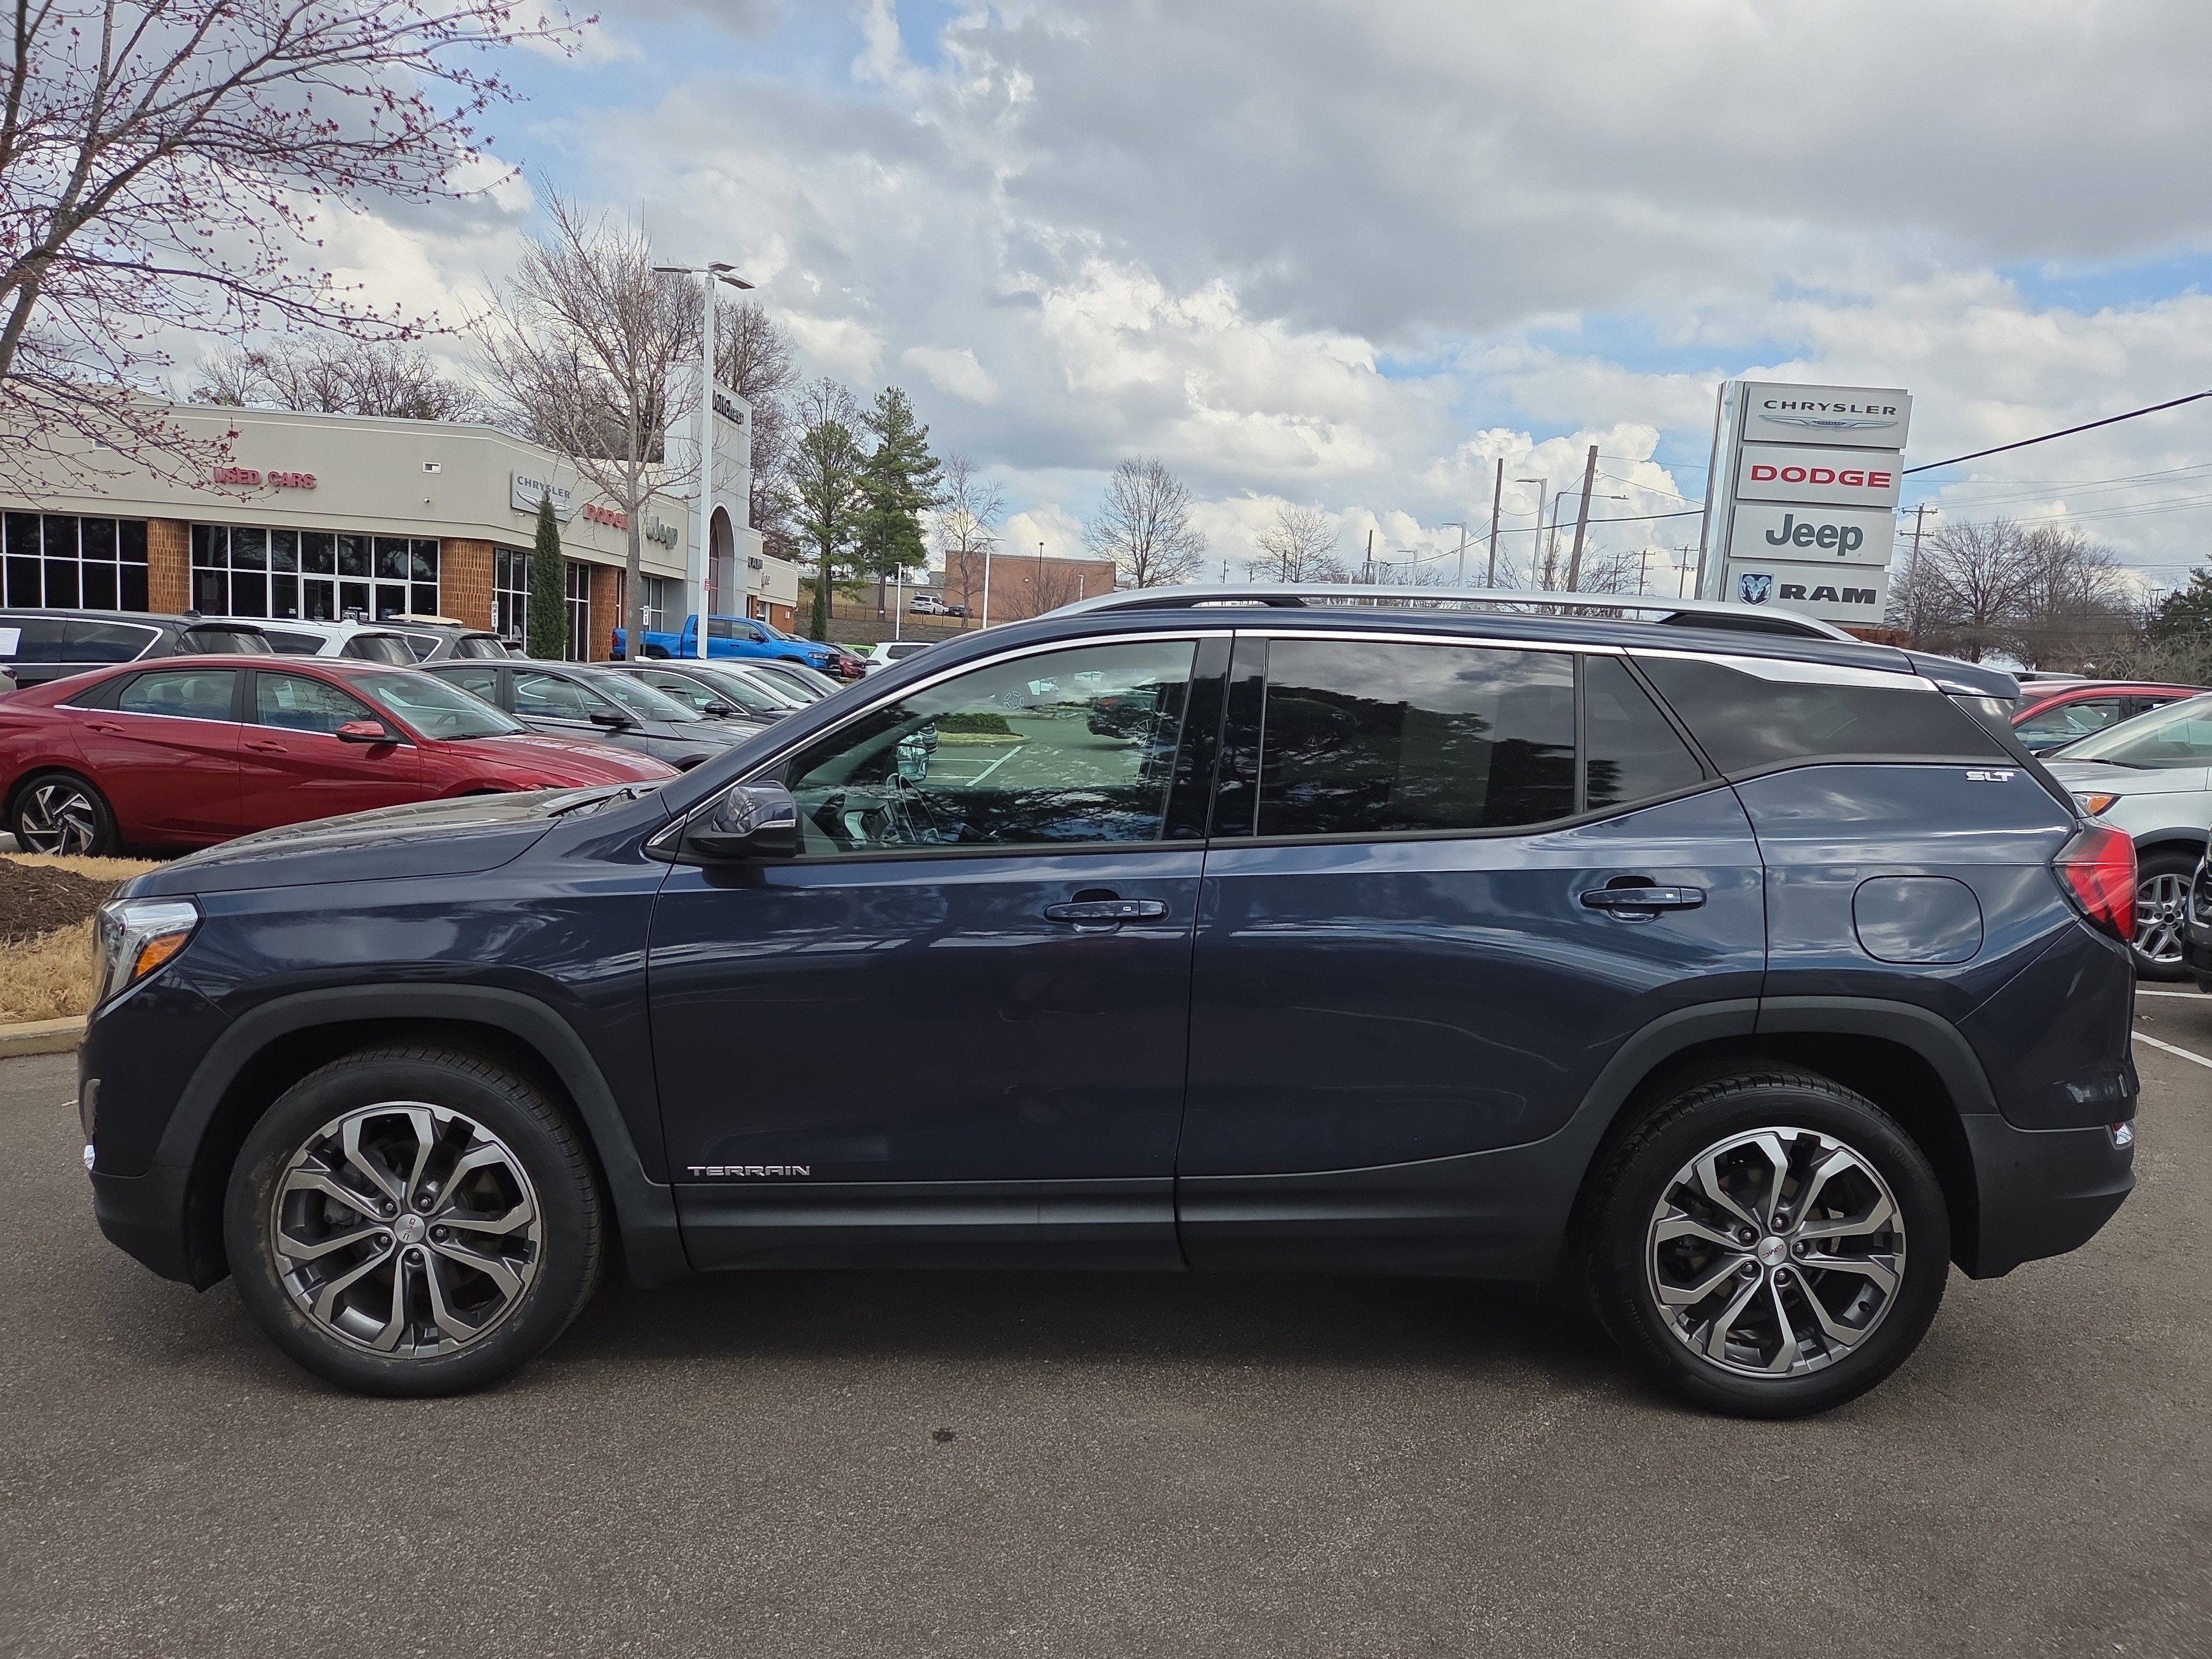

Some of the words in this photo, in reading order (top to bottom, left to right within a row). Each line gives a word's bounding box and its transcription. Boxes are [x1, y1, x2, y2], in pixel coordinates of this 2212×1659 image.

[1764, 400, 1897, 415] CHRYSLER
[213, 466, 262, 485] USED
[268, 471, 317, 489] CARS
[517, 475, 571, 499] CHRYSLER
[1751, 465, 1892, 488] DODGE
[646, 516, 678, 550] Jeep
[1765, 513, 1864, 556] Jeep
[1779, 583, 1877, 605] RAM
[1966, 771, 2015, 782] SLT
[687, 1166, 811, 1176] TERRAIN
[403, 1217, 416, 1240] GMC
[1761, 1244, 1784, 1259] GMC
